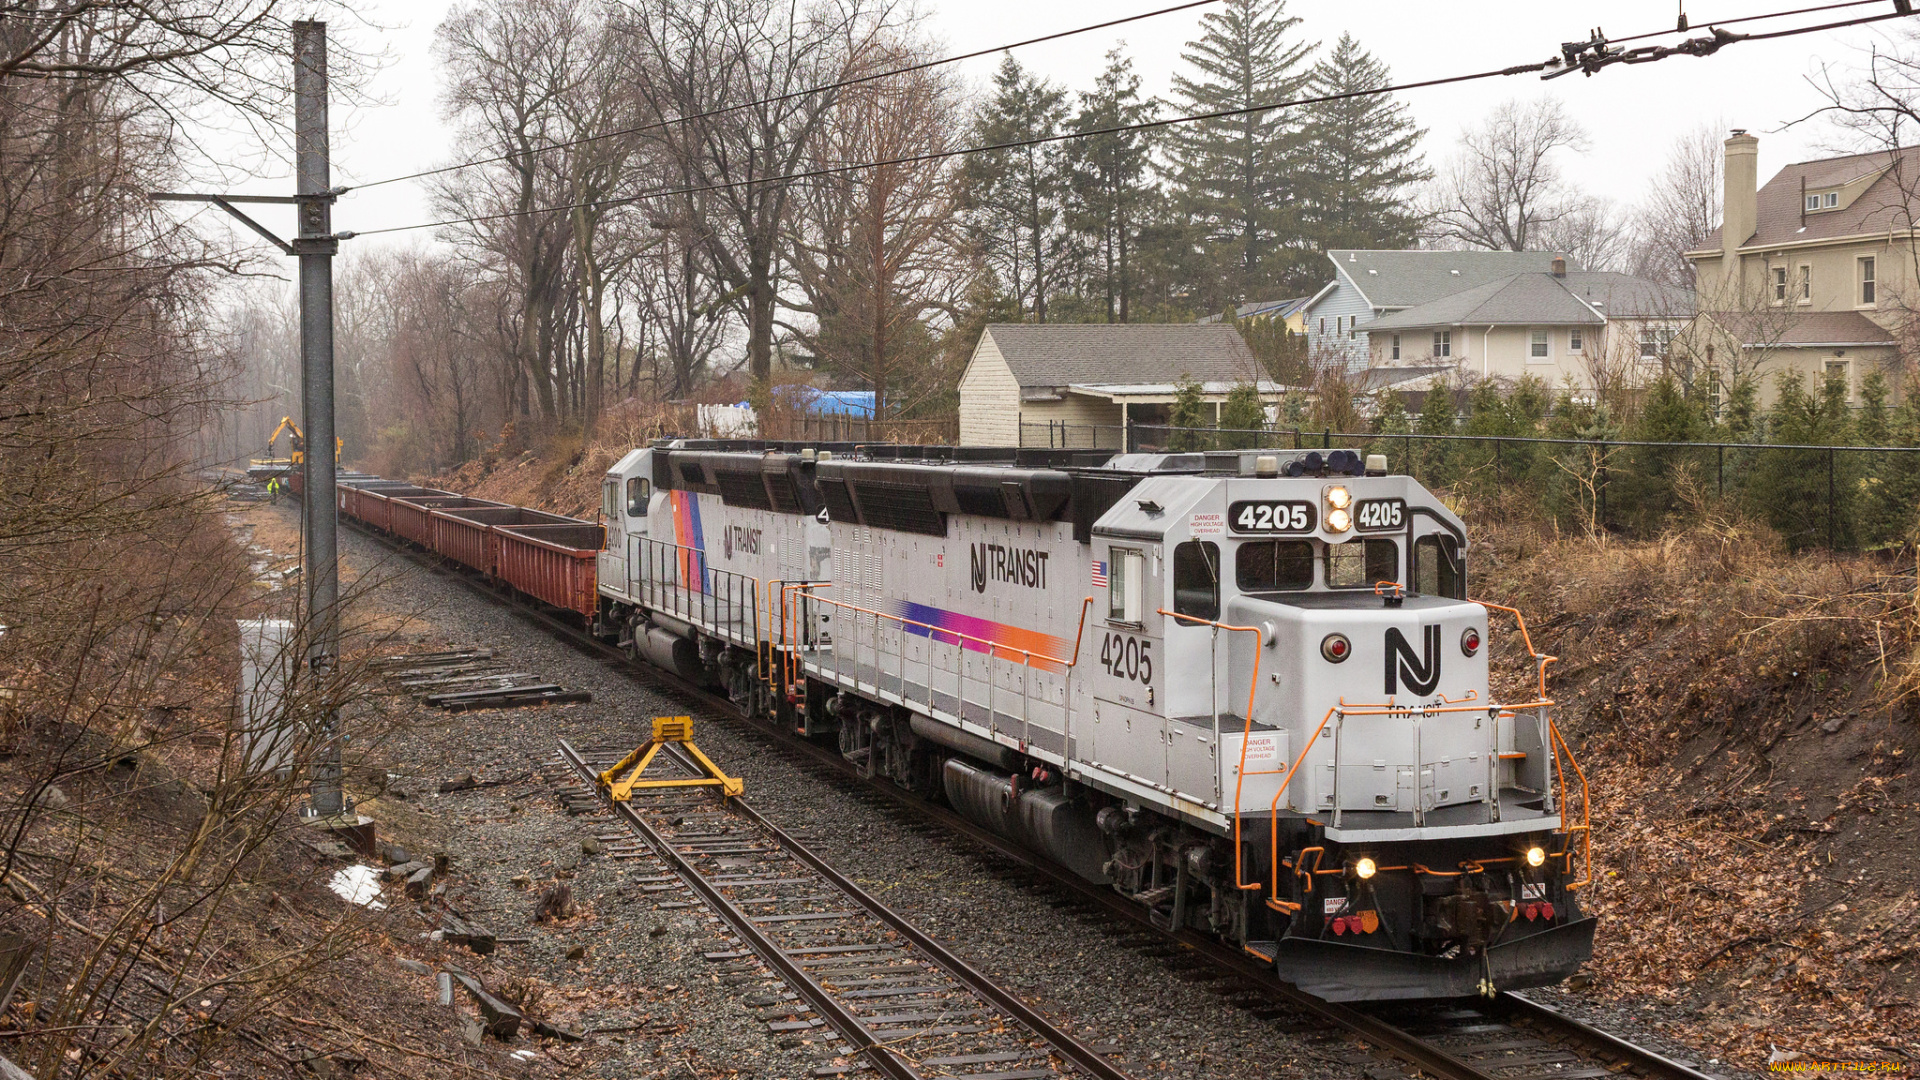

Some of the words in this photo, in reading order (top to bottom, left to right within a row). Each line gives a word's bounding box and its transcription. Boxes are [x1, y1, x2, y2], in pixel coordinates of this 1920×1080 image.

[1238, 505, 1308, 529] 4205
[1359, 502, 1402, 527] 4205
[724, 524, 733, 561] NJ
[734, 525, 762, 556] TRANSIT
[970, 542, 987, 594] NJ
[987, 543, 1049, 590] TRANSIT
[1101, 631, 1152, 685] 4205
[1384, 623, 1441, 697] NJ
[1326, 898, 1347, 906] DANGE
